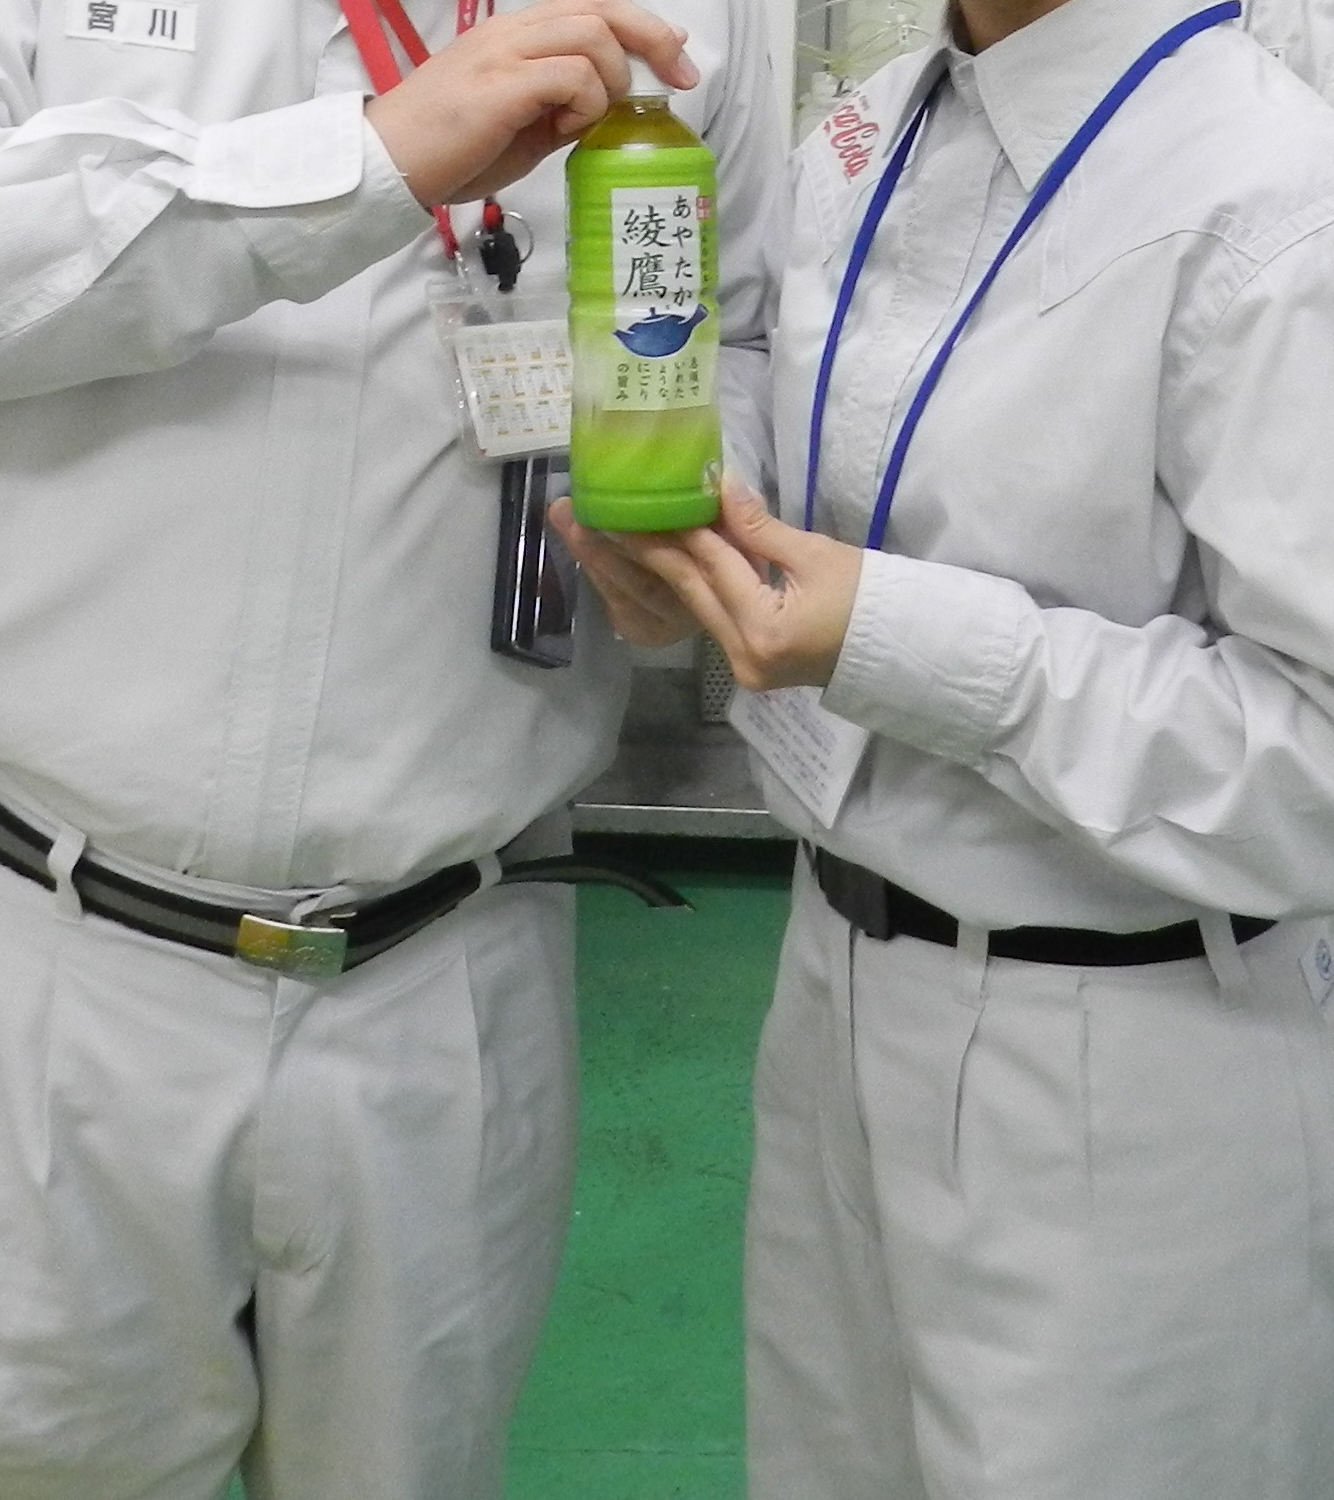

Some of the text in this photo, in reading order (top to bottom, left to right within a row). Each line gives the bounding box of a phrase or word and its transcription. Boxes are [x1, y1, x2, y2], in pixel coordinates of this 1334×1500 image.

[87, 0, 178, 41] 宮川
[621, 204, 672, 299] 綾鷹
[672, 194, 694, 307] あやたか
